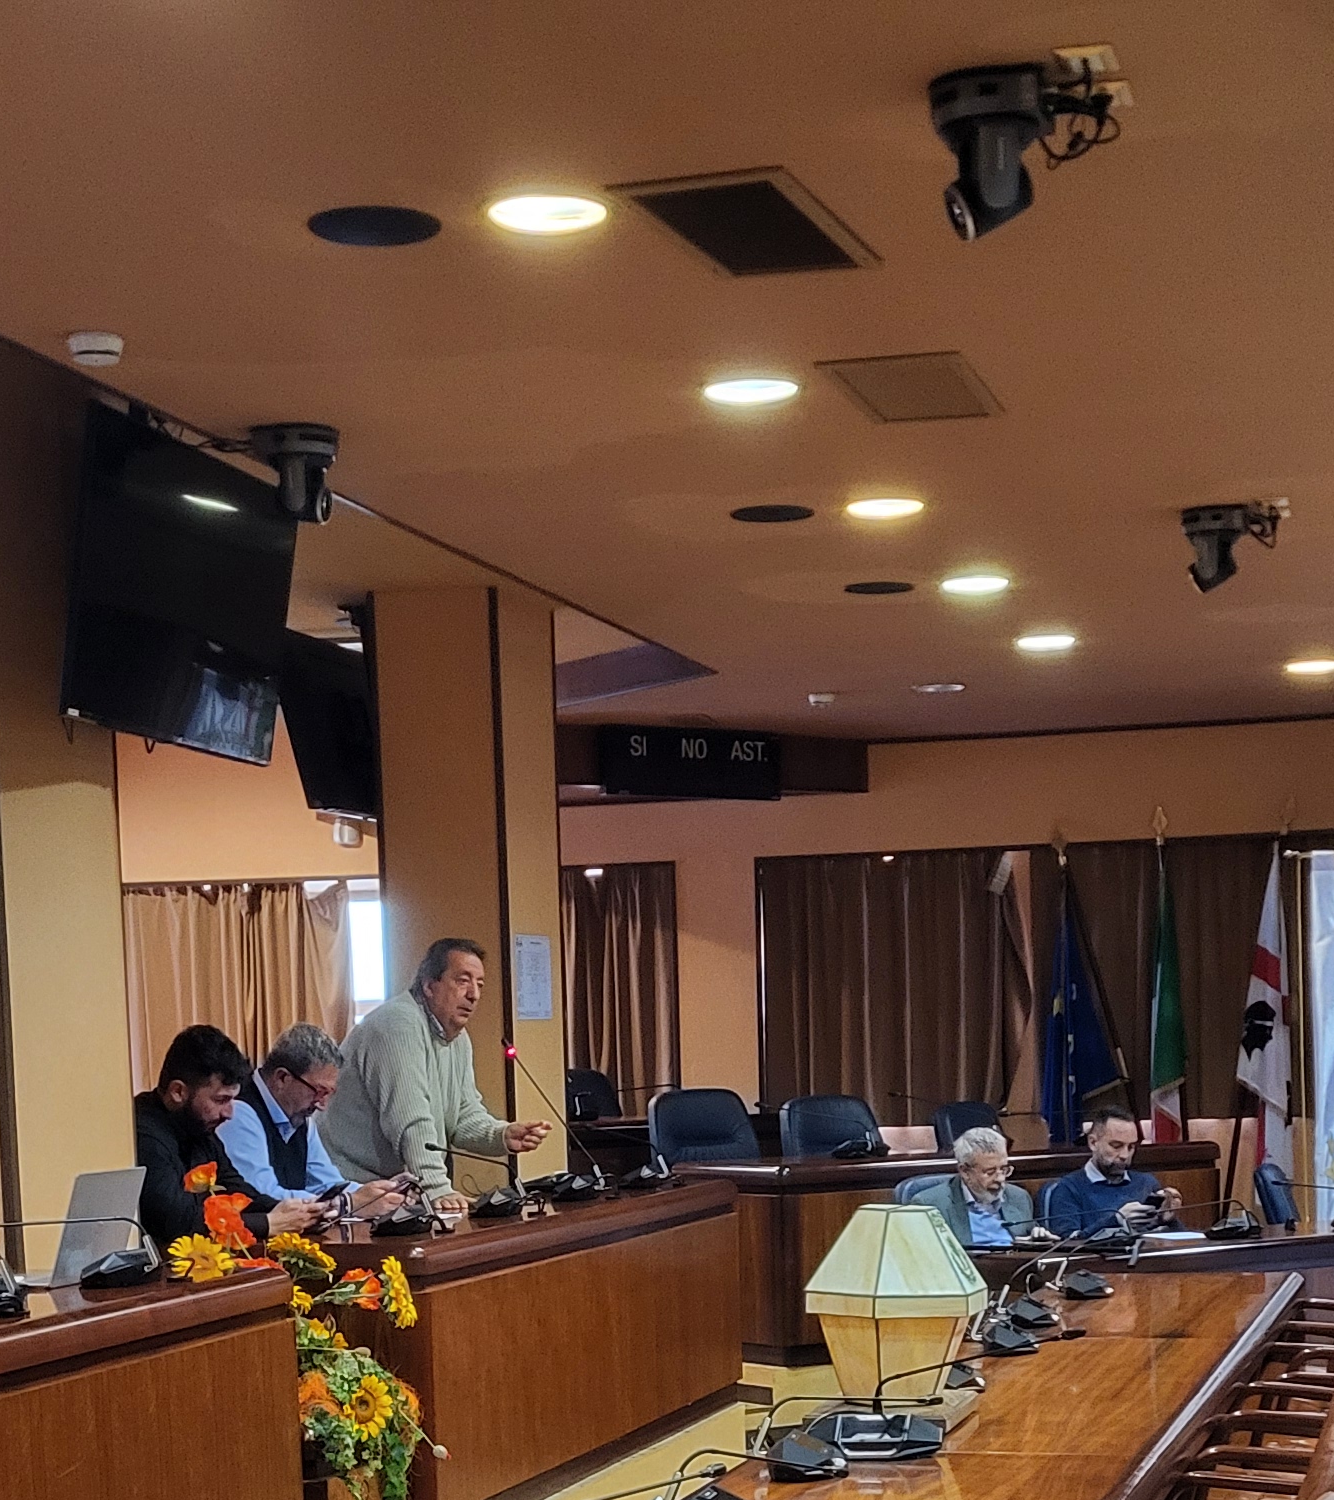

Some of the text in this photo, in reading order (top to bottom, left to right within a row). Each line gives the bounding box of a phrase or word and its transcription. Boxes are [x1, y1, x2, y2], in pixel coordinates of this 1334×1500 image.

[630, 735, 768, 762] SI NO AST.
